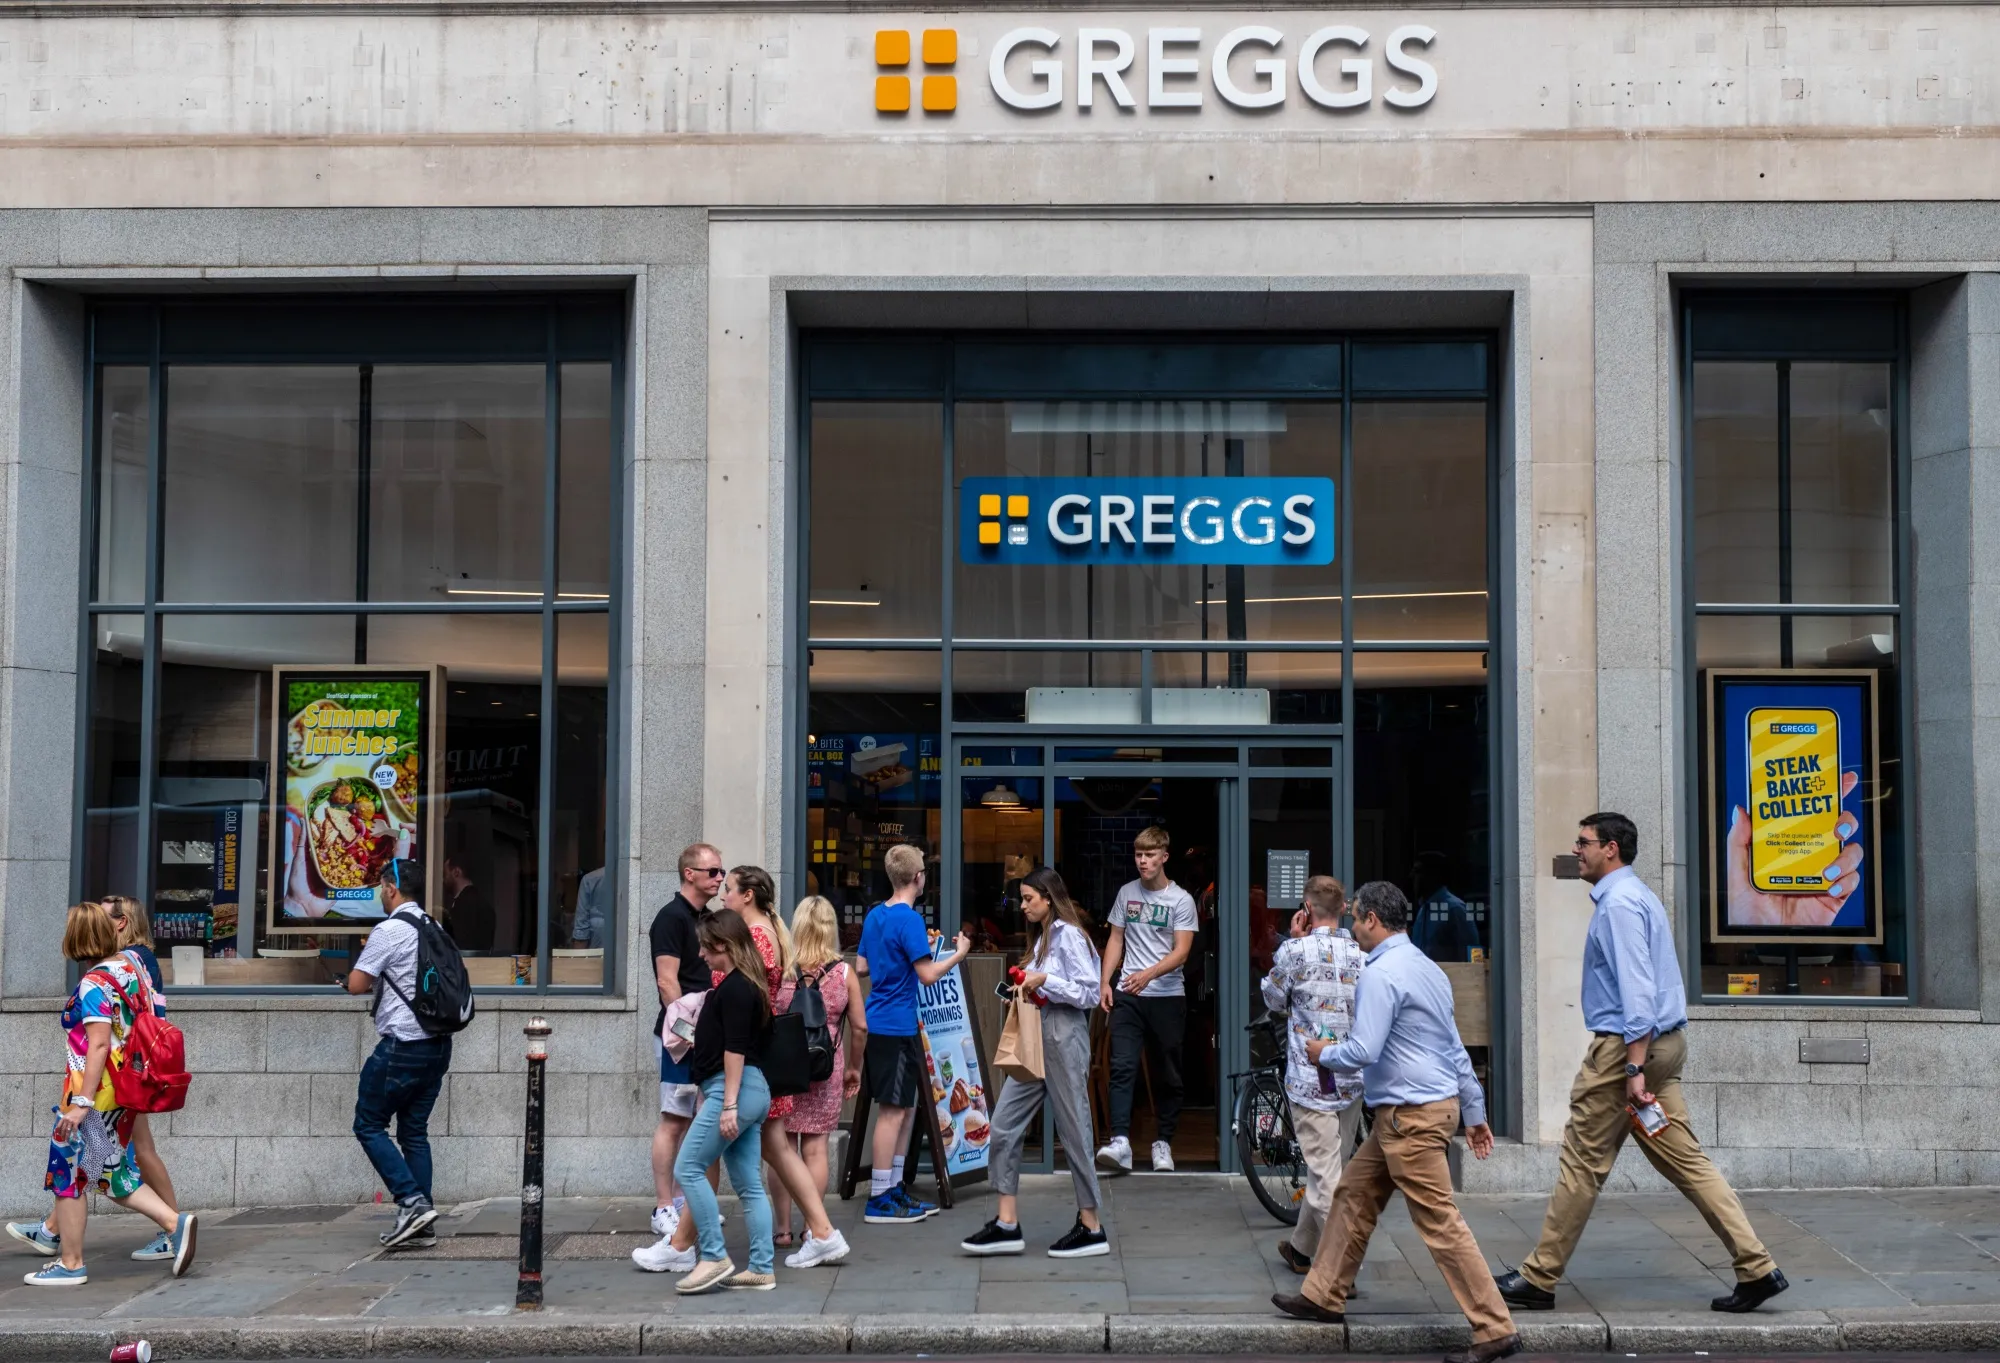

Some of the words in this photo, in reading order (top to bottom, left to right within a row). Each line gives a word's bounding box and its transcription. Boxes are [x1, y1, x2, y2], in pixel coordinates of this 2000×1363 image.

[988, 25, 1439, 110] GREGGS
[1047, 494, 1316, 546] GREGGS
[304, 703, 401, 729] Summer
[1780, 725, 1815, 733] GREGGS
[305, 731, 399, 757] lunches
[820, 738, 844, 749] BITES
[808, 751, 824, 761] EAL
[826, 751, 844, 761] BOX
[1764, 754, 1822, 777] STEAK
[375, 770, 395, 778] NEW
[1759, 794, 1833, 820] COLLECT
[226, 810, 237, 832] COLD
[880, 822, 905, 836] COFFEE
[224, 833, 236, 891] SANDWICH
[336, 890, 372, 898] GREGGS
[916, 978, 959, 1009] LOVES
[921, 1005, 963, 1026] MORNINGS
[117, 1344, 135, 1352] COSTA
